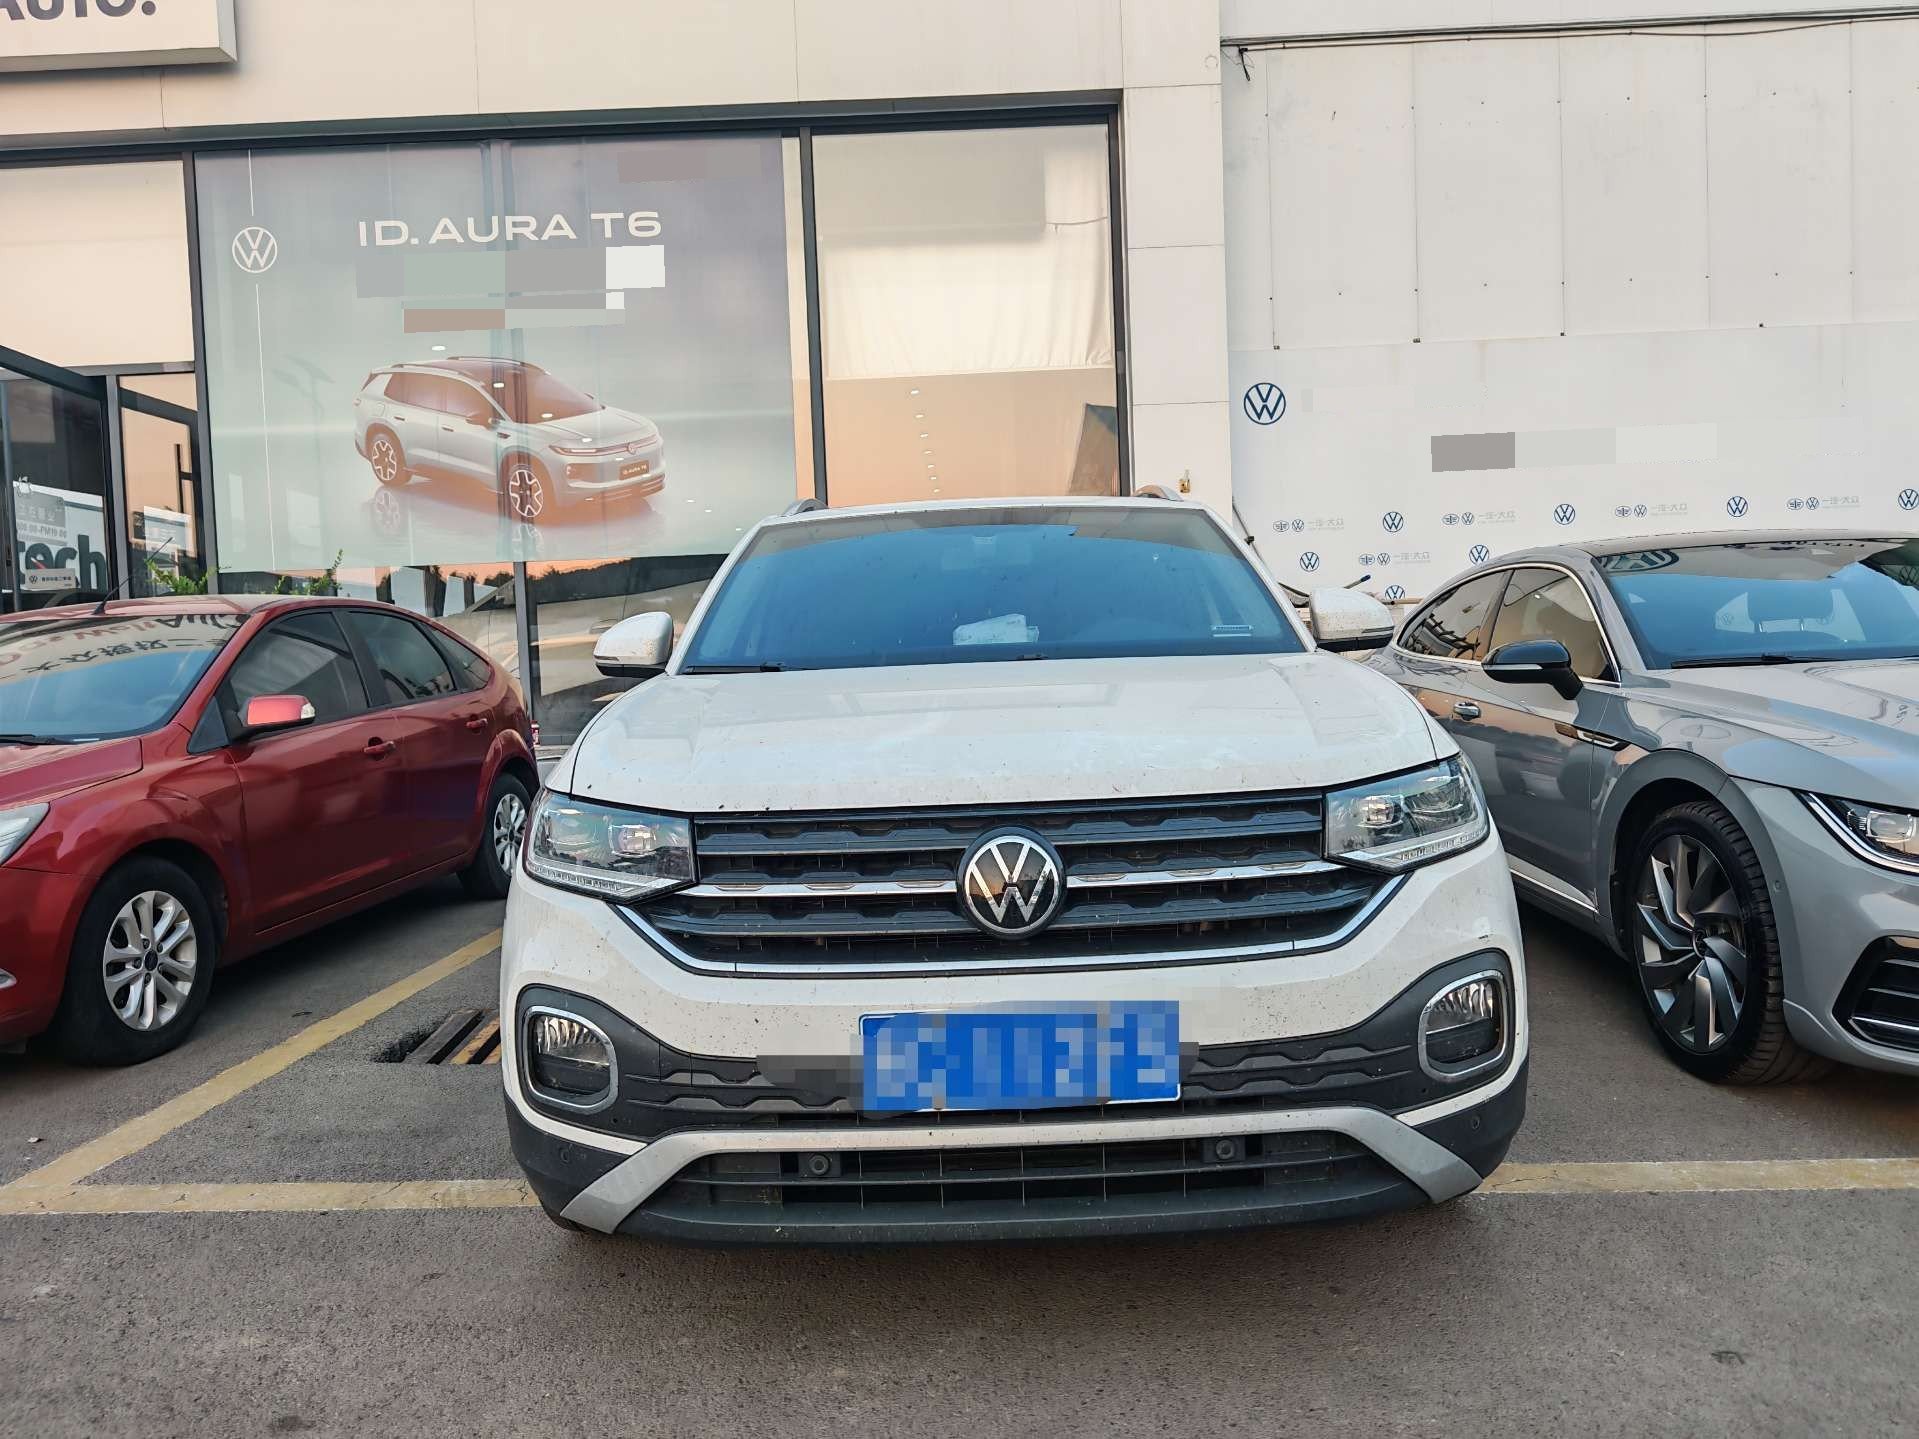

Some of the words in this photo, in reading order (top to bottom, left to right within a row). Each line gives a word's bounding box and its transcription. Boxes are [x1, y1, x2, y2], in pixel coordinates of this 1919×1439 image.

[359, 220, 418, 246] ID.
[428, 214, 577, 244] AURA
[591, 211, 662, 238] T6
[964, 835, 1060, 934] VW
